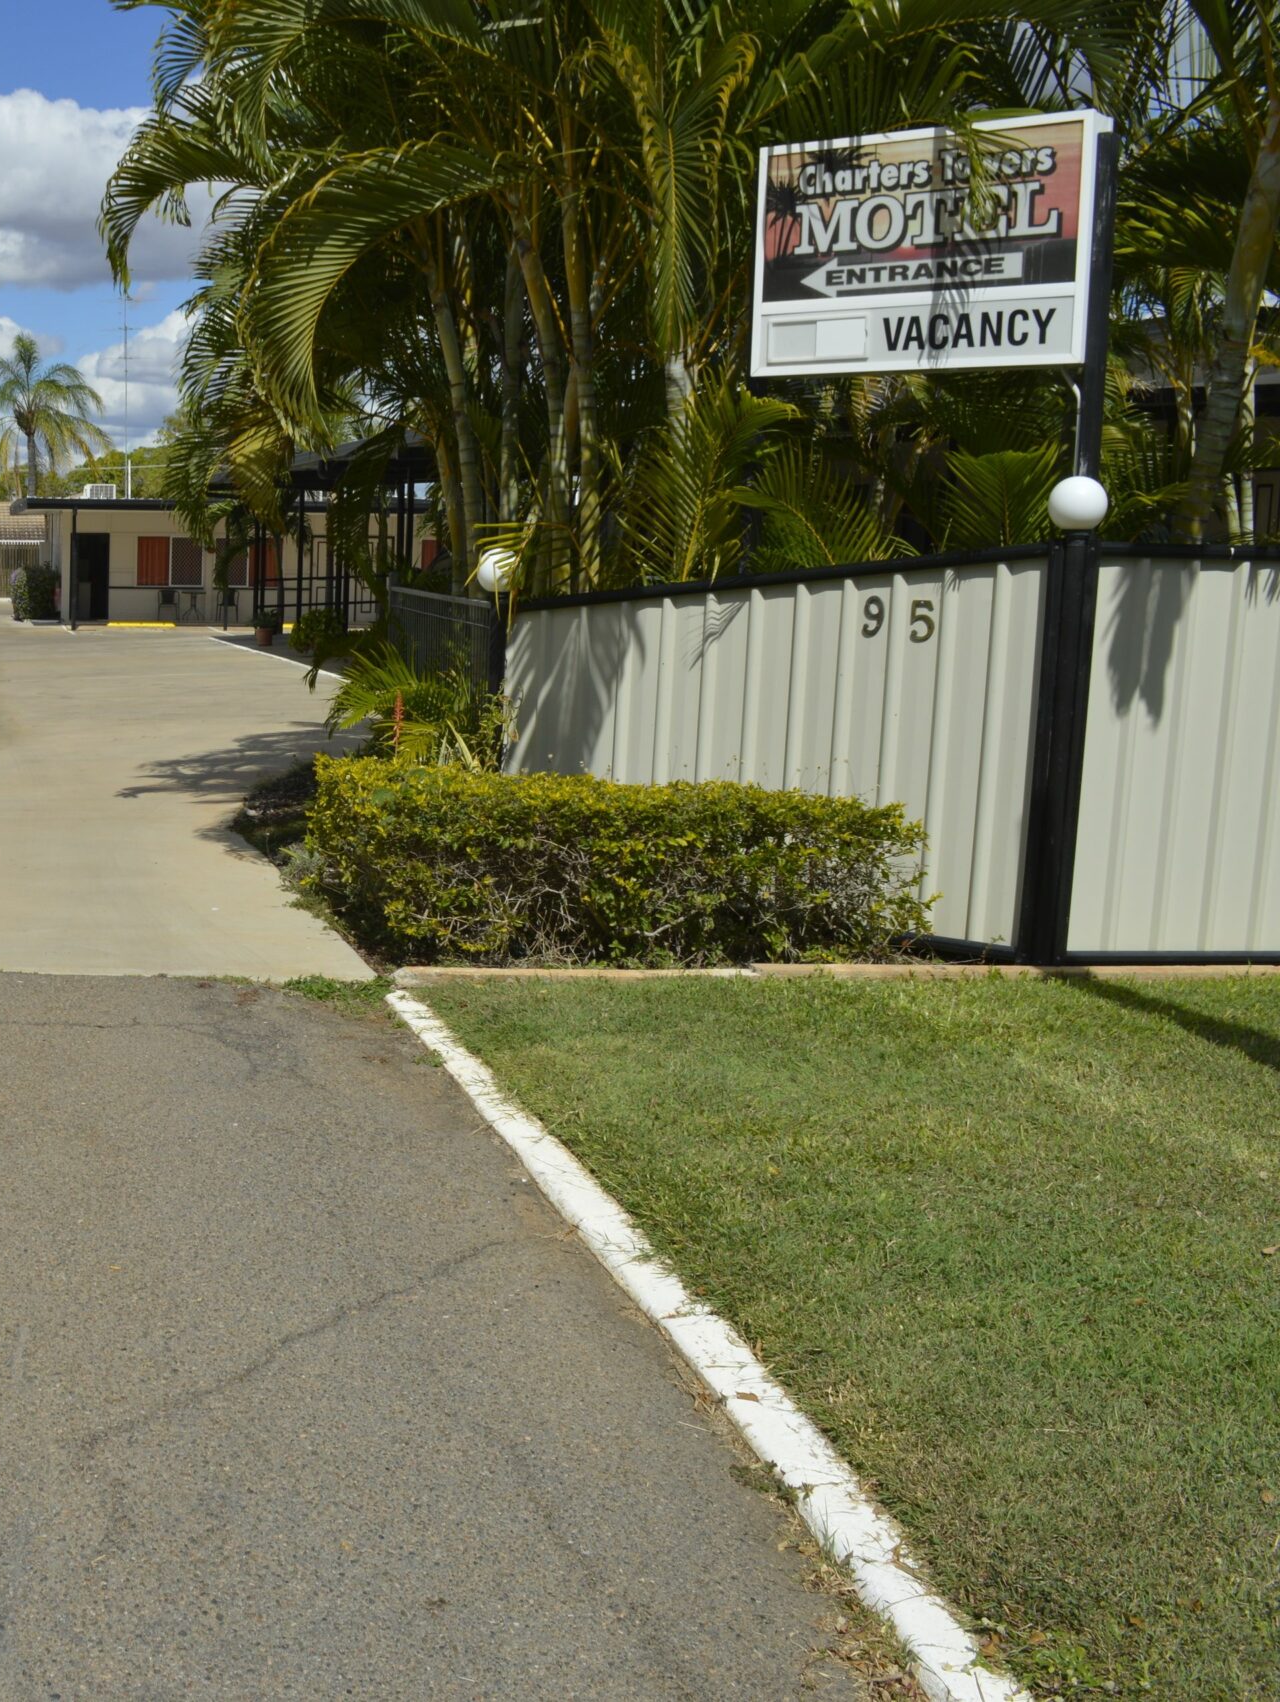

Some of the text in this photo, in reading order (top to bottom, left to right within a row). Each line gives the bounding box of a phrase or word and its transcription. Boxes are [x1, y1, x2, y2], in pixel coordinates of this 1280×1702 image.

[799, 159, 931, 196] Charters
[793, 181, 1062, 255] MOTEL
[825, 256, 1005, 287] ENTRANCE
[883, 308, 1057, 352] VACANCY
